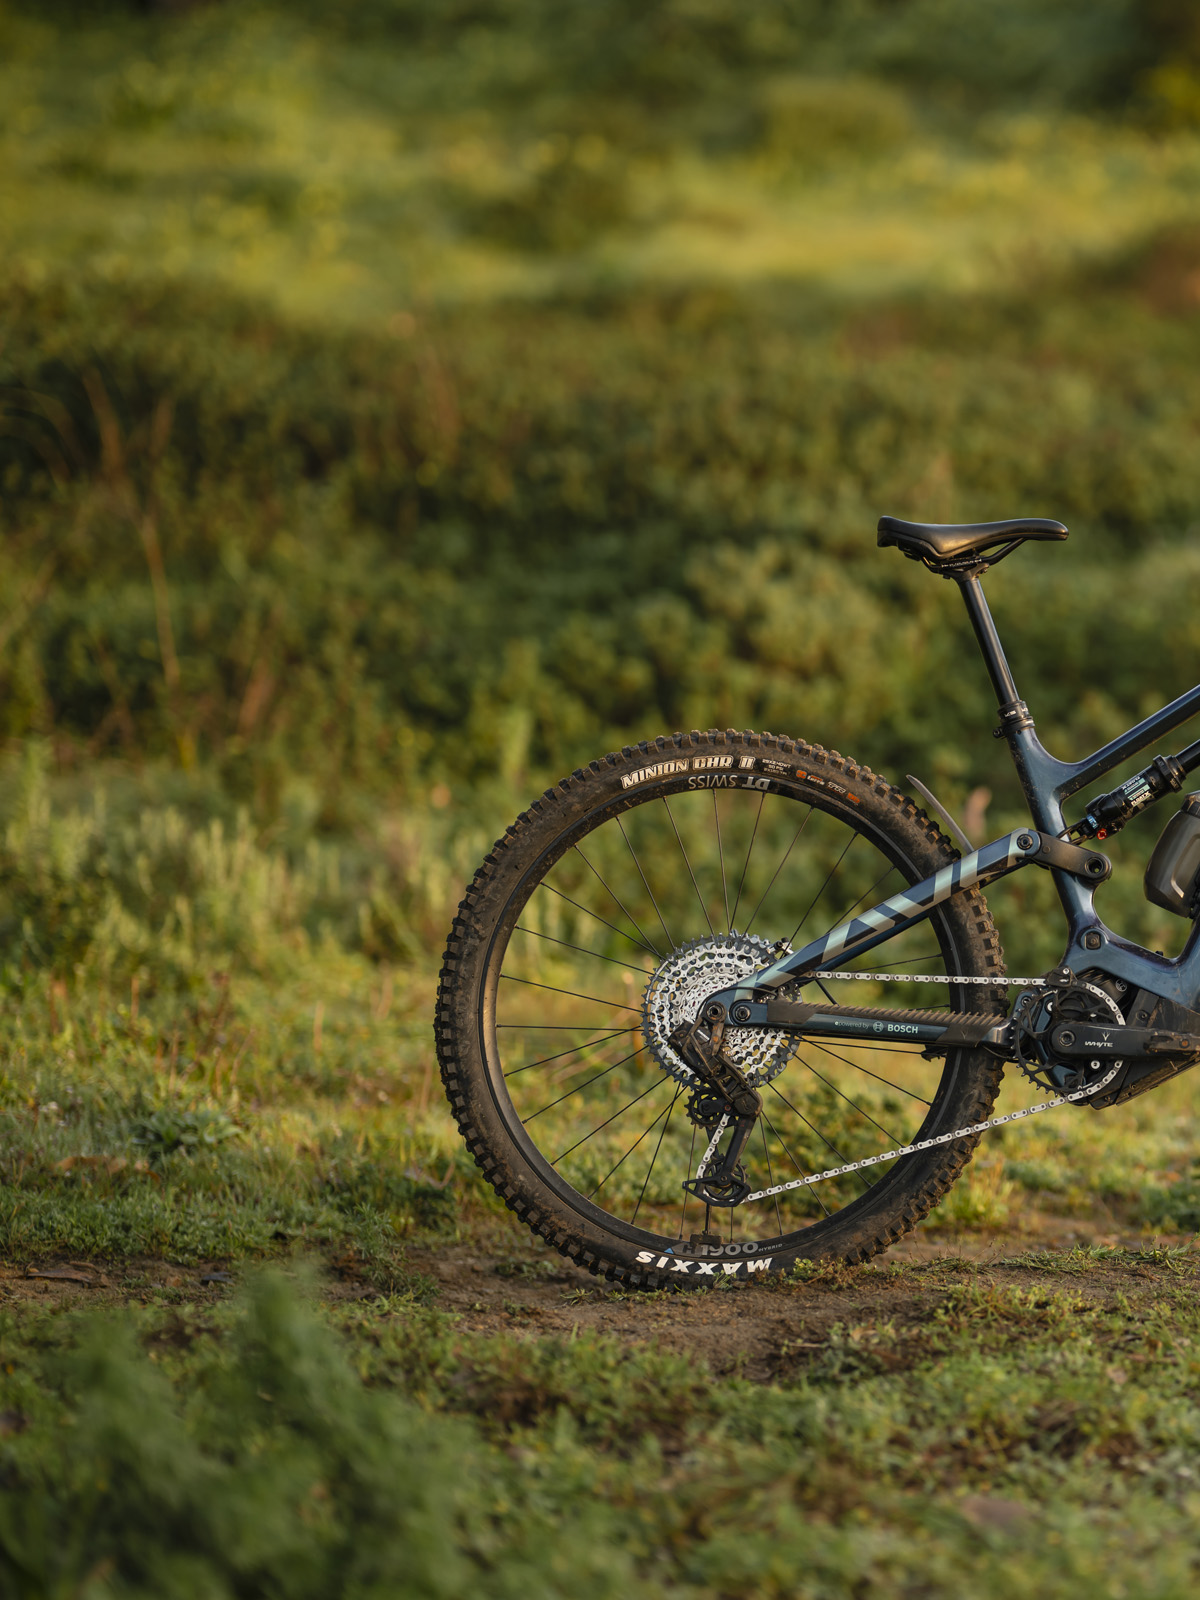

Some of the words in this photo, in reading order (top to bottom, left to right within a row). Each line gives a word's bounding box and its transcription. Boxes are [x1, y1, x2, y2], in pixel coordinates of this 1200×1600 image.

[621, 758, 689, 789] MINION
[693, 755, 733, 770] DHR
[738, 755, 756, 770] II
[688, 775, 738, 789] SWISS
[742, 778, 771, 790] DT
[887, 1024, 919, 1034] BOSCH
[1084, 1040, 1113, 1048] WHYTE
[635, 1251, 773, 1275] MAXXIS
